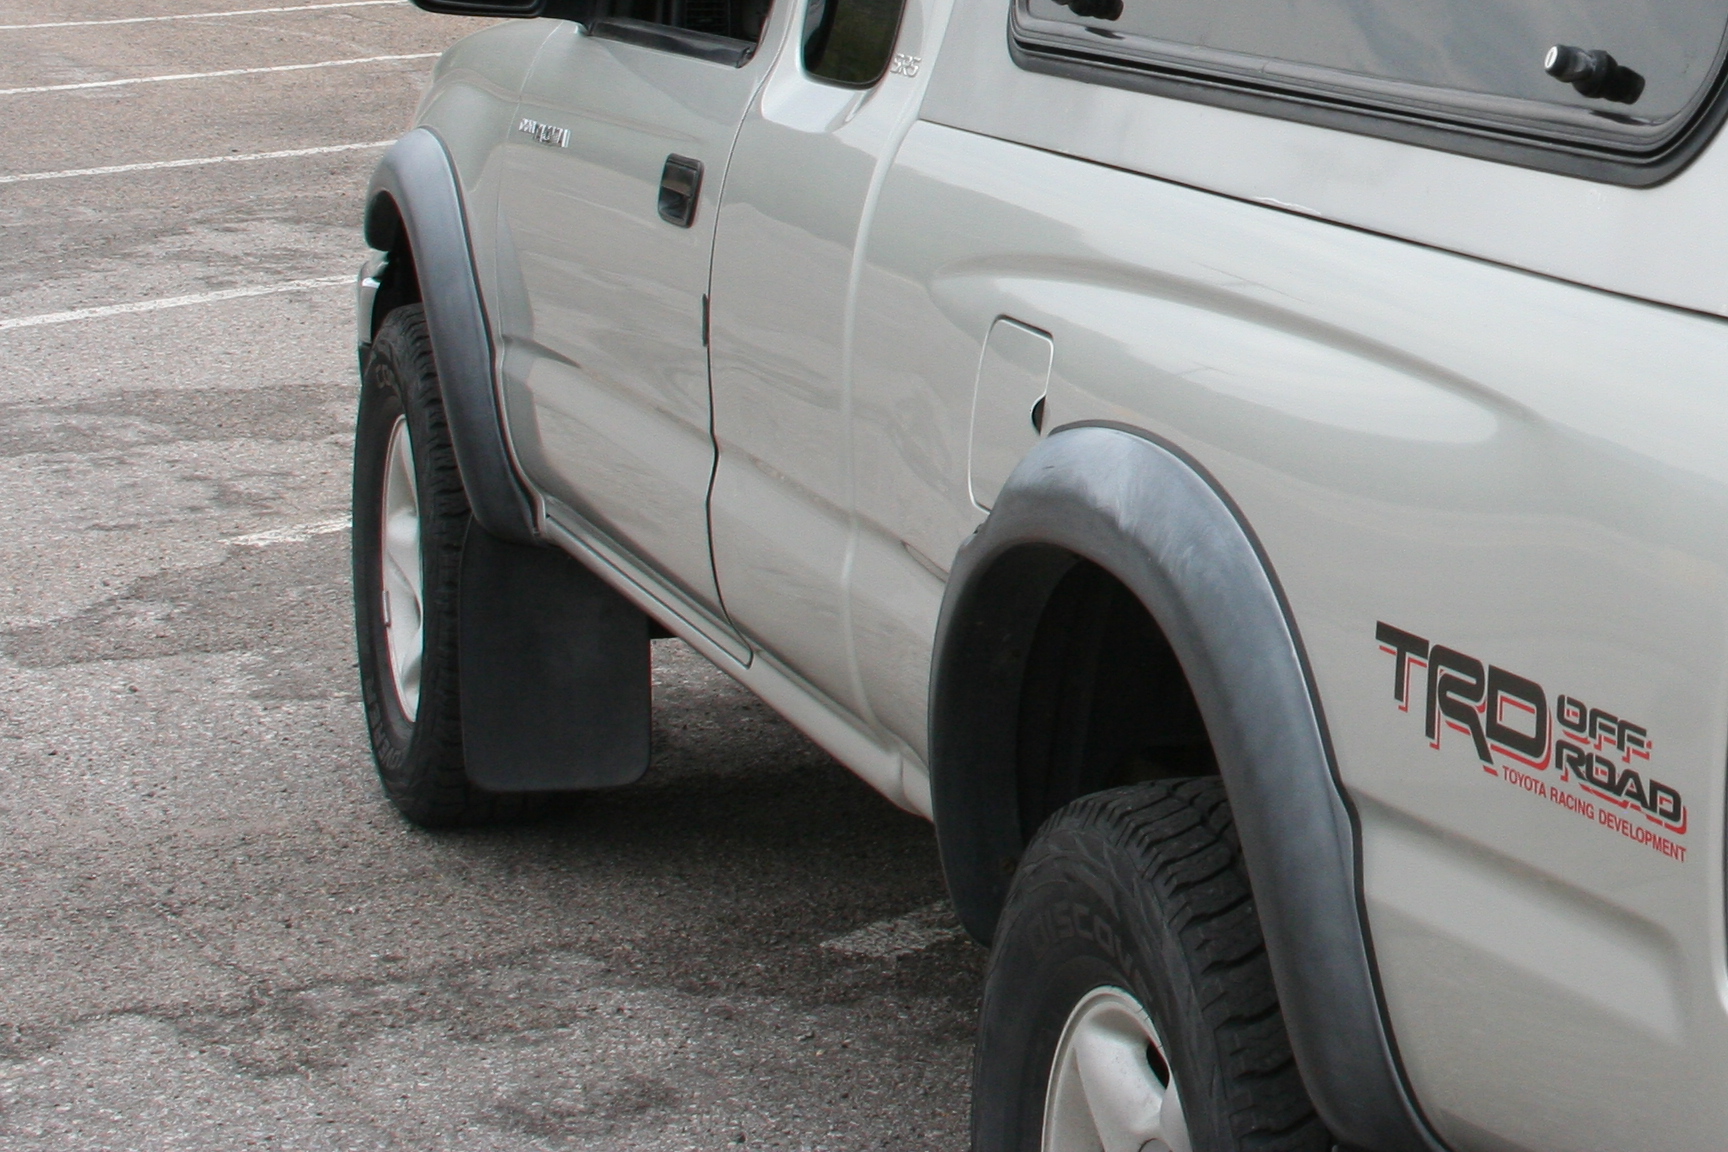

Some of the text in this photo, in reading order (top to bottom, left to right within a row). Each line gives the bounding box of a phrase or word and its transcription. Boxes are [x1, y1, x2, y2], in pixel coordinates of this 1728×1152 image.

[891, 54, 921, 77] SR5
[1375, 620, 1551, 776] TRD
[1556, 694, 1652, 763] OFF
[1502, 765, 1687, 862] TOYOTA RACING DEVELOPMENT
[1555, 739, 1687, 835] ROAD
